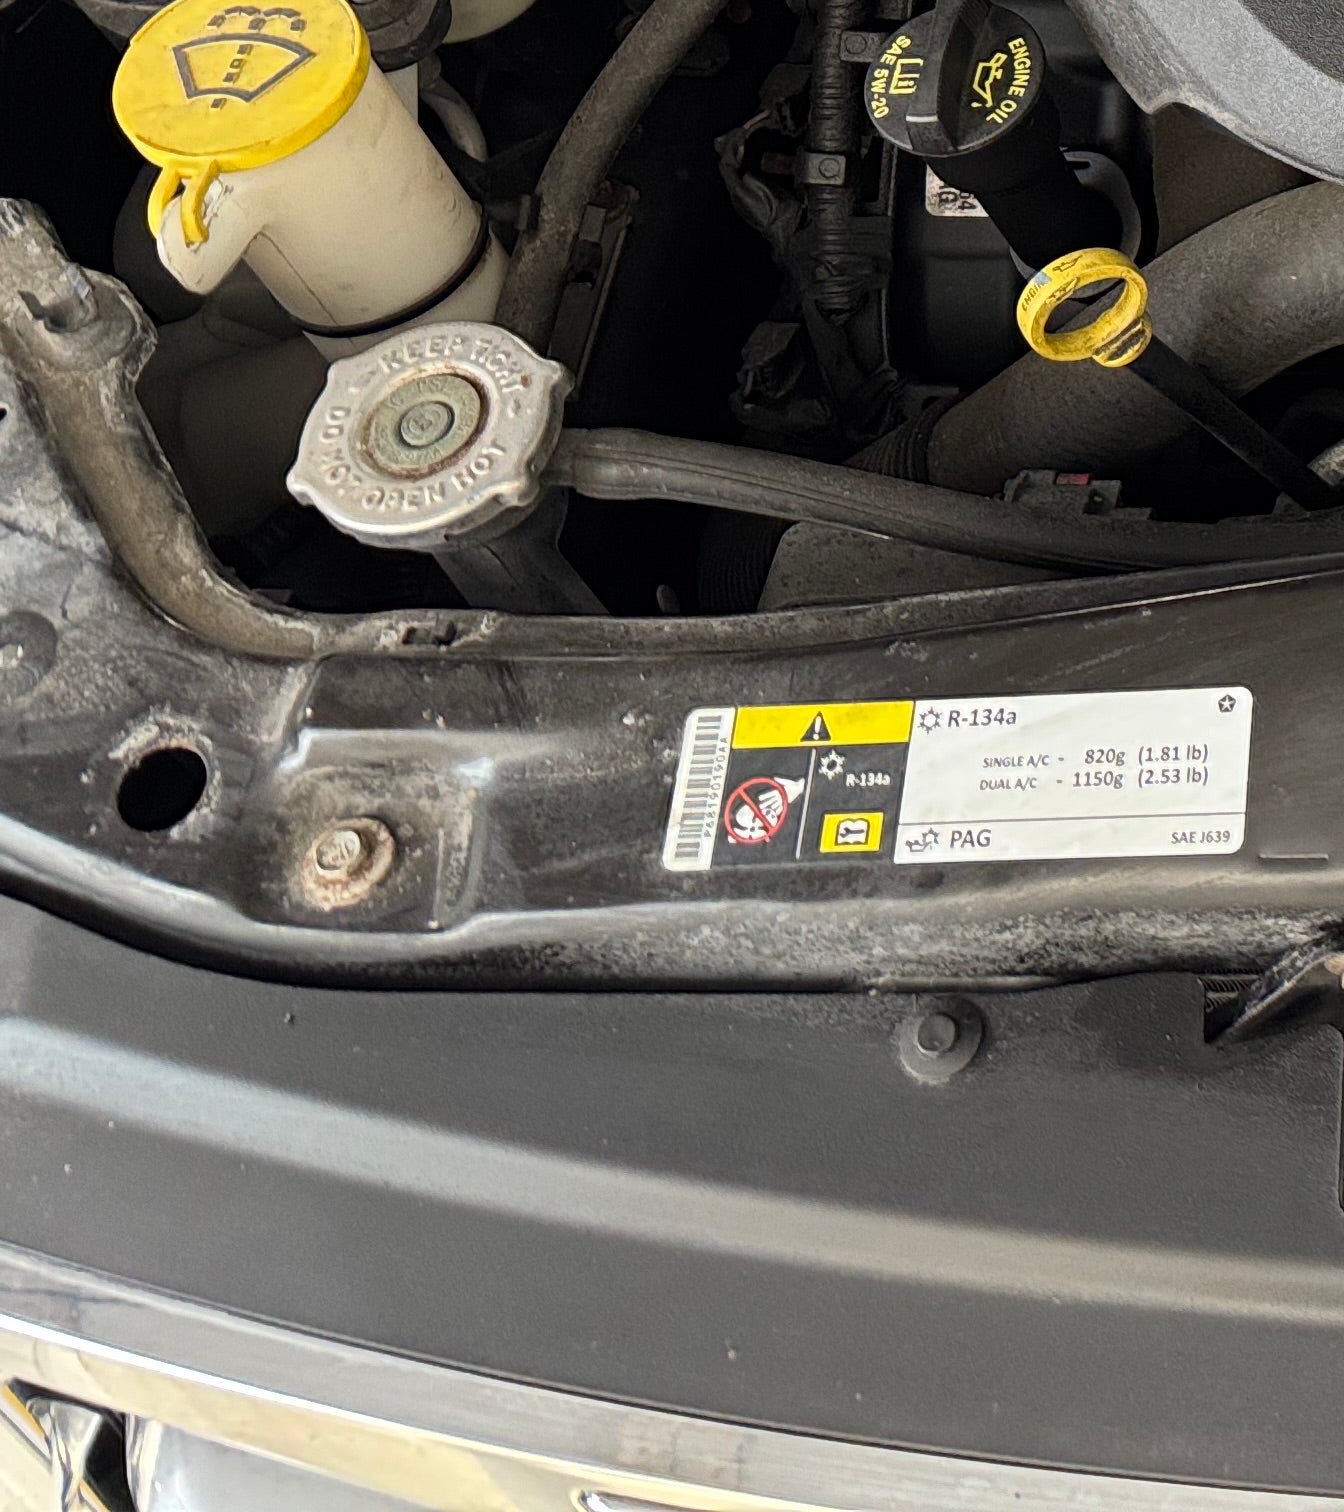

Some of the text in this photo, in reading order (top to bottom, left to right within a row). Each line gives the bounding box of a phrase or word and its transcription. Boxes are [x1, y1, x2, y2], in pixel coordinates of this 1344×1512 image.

[871, 35, 912, 120] SAE 5W-20
[986, 36, 1032, 124] ENGINE OIL
[377, 337, 463, 374] KEEP
[362, 480, 447, 512] OPEN
[452, 446, 506, 491] HOT
[947, 707, 1018, 727] R-134a
[982, 743, 1208, 769] SINGLE A/C 820g (1.81 lb)
[844, 771, 892, 787] R-134a
[979, 766, 1209, 791] DUAL A/C 1150g (2.53 lb)
[949, 828, 992, 849] PAG
[1171, 830, 1230, 844] SAE J639
